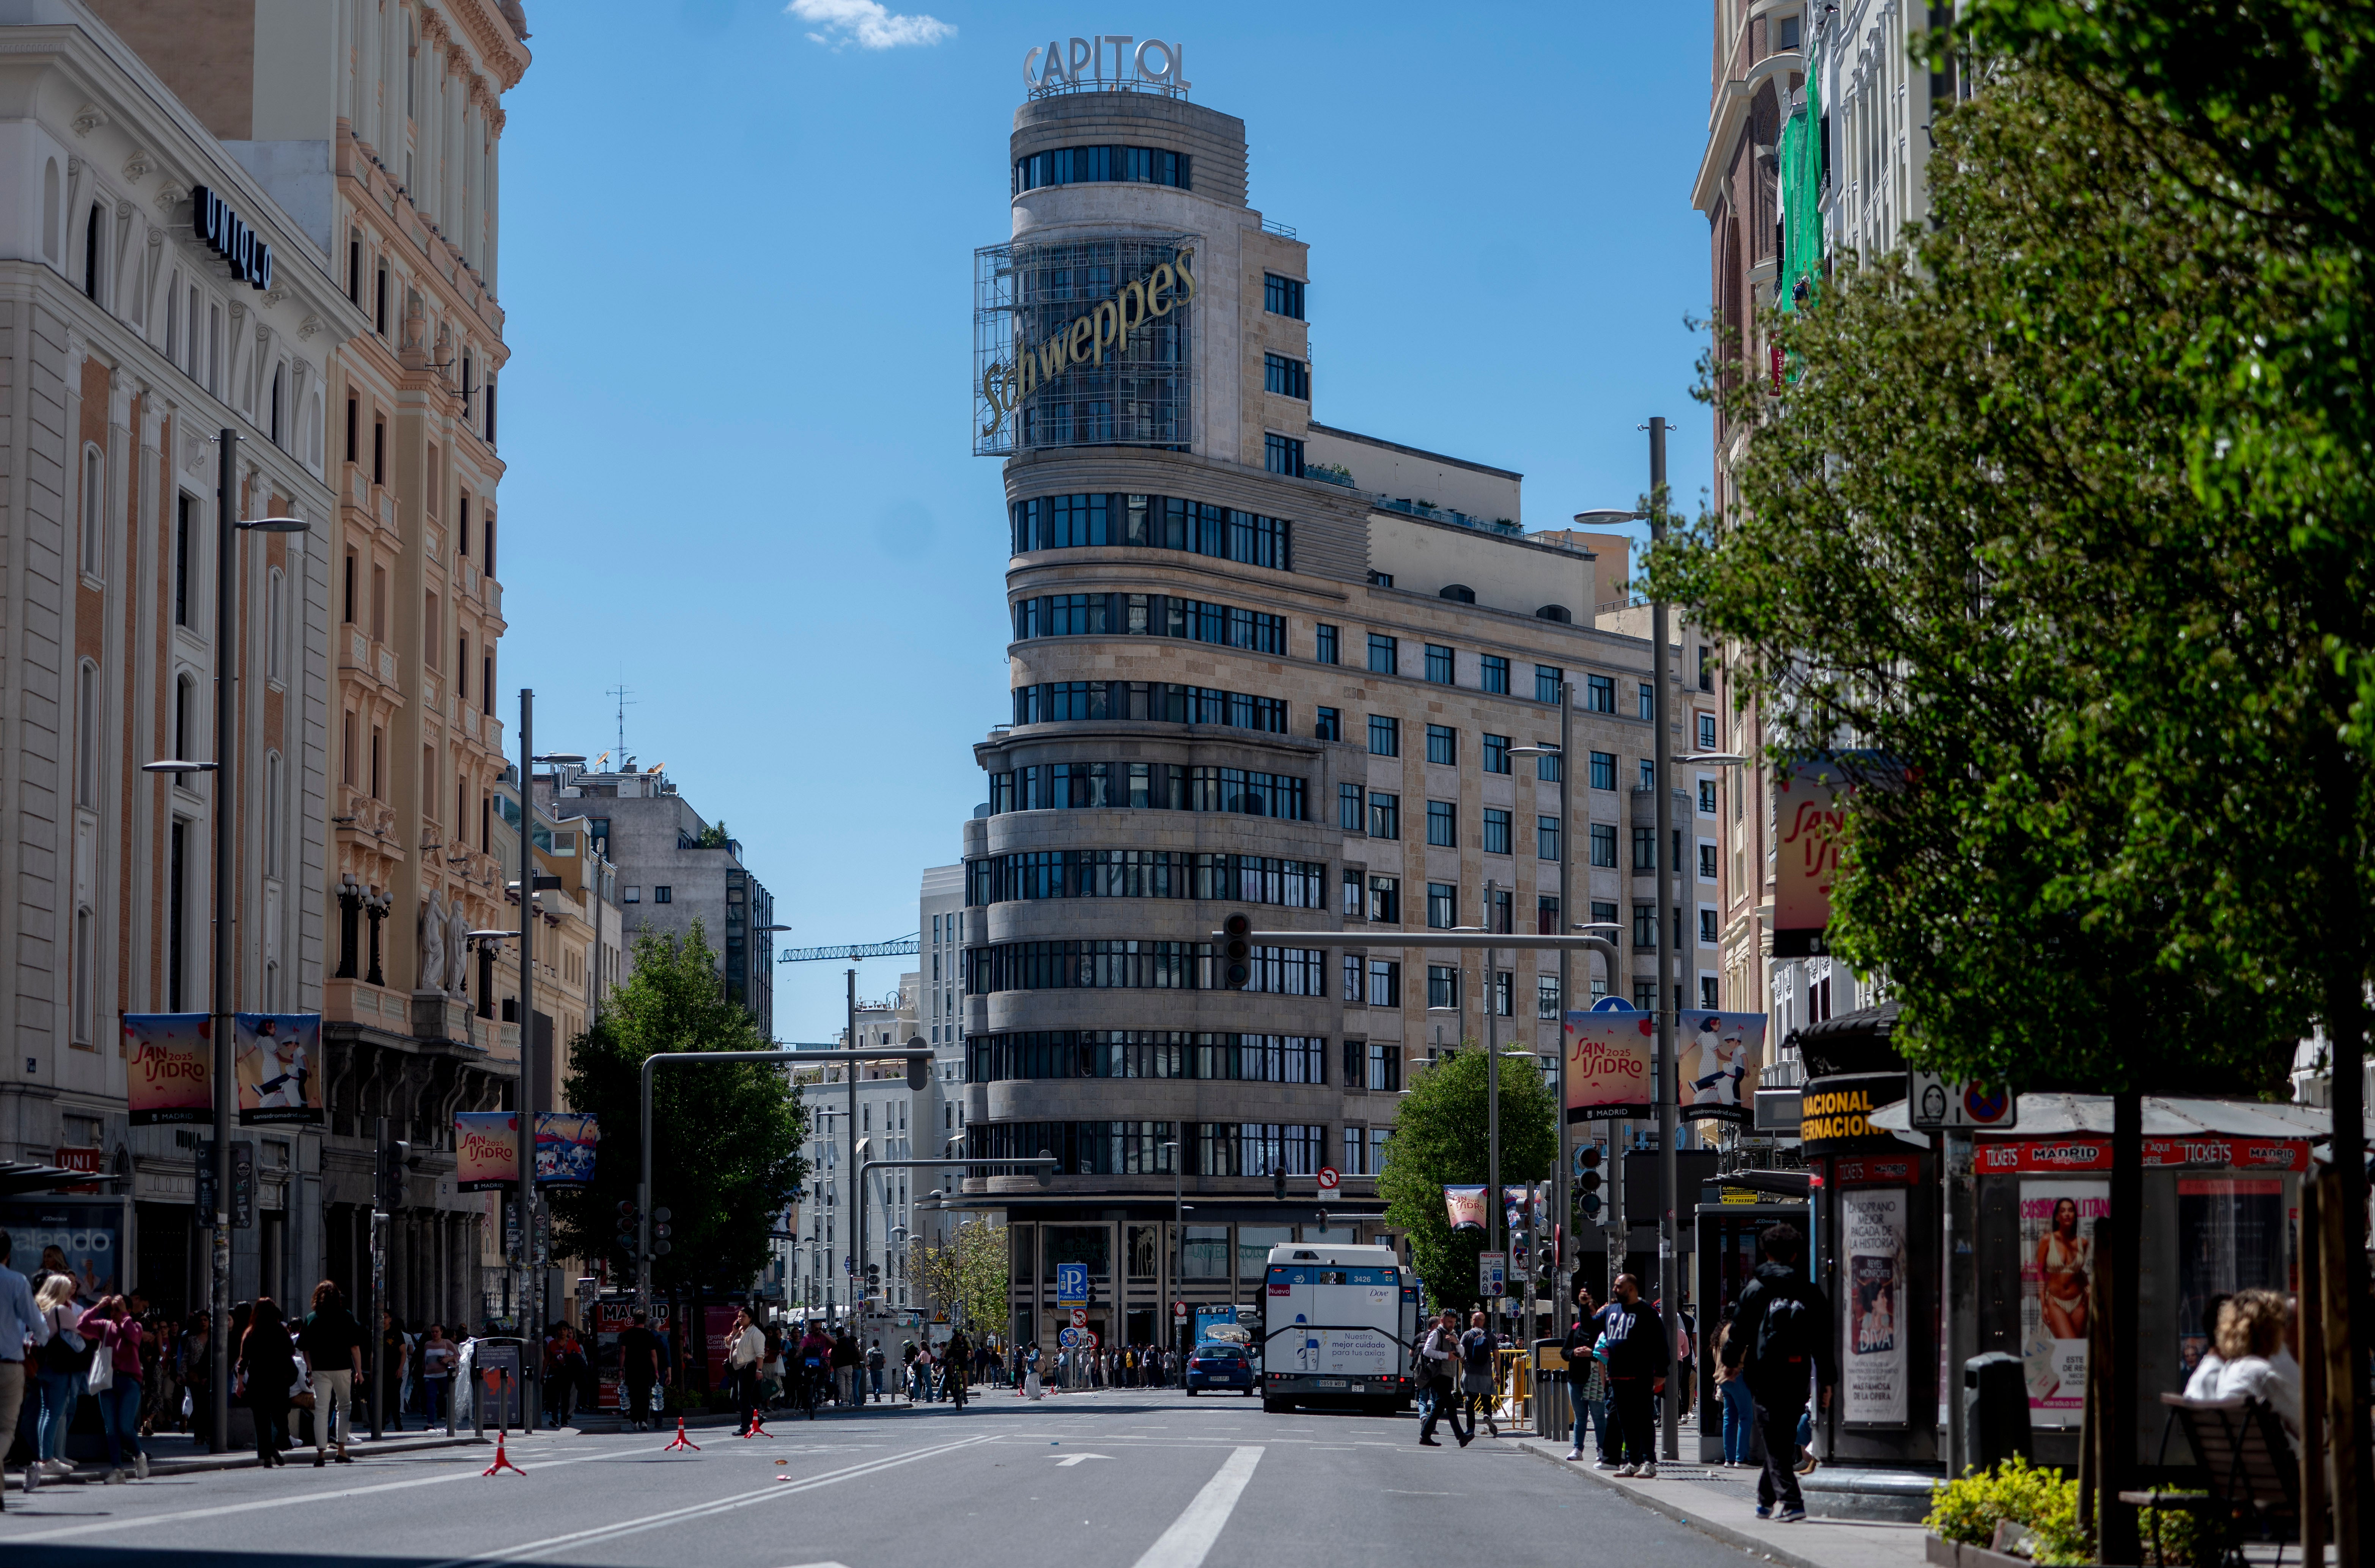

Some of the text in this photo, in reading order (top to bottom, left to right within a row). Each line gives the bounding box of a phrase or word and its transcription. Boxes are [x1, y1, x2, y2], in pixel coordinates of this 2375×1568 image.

[1023, 35, 1192, 89] CAPITOL
[200, 186, 272, 291] UNIQLO
[983, 247, 1196, 438] Schweppes
[132, 1042, 193, 1064] SAN 2025
[1571, 1037, 1604, 1061] SAN
[146, 1059, 205, 1082] ISIDRO
[1584, 1055, 1642, 1079] ISIDRO
[1803, 1090, 1874, 1117] NACIONAL
[1689, 1109, 1741, 1118] sanisidromadrid.com
[1800, 1114, 1891, 1142] TERNACION
[460, 1133, 485, 1149] SAN
[470, 1145, 512, 1161] ISIDRO
[1985, 1147, 2018, 1167] TICKETS
[2032, 1145, 2100, 1161] MADRID
[2142, 1156, 2162, 1164] HERE
[2184, 1144, 2232, 1162] TICKETS
[2249, 1147, 2296, 1159] MADRID
[61, 1155, 90, 1169] UNI
[1874, 1163, 1908, 1174] MADRID
[1839, 1163, 1864, 1180] TICKETS
[1858, 1201, 1896, 1213] SOPRANO
[2021, 1199, 2110, 1219] COSMLITAN
[1858, 1214, 1884, 1224] MEJOR
[1851, 1225, 1892, 1236] PAGADA DE
[11, 1229, 110, 1252] alando
[1850, 1238, 1894, 1249] LA HISTORIA
[1193, 1244, 1227, 1258] UNITED
[1867, 1259, 1883, 1268] REYES
[1860, 1268, 1891, 1278] MONFORTE
[1065, 1271, 1082, 1294] P
[1370, 1288, 1389, 1297] Dove
[1606, 1312, 1637, 1340] GAP
[1860, 1328, 1892, 1351] DIVA
[1854, 1392, 1861, 1400] DE
[1861, 1392, 1868, 1400] LA
